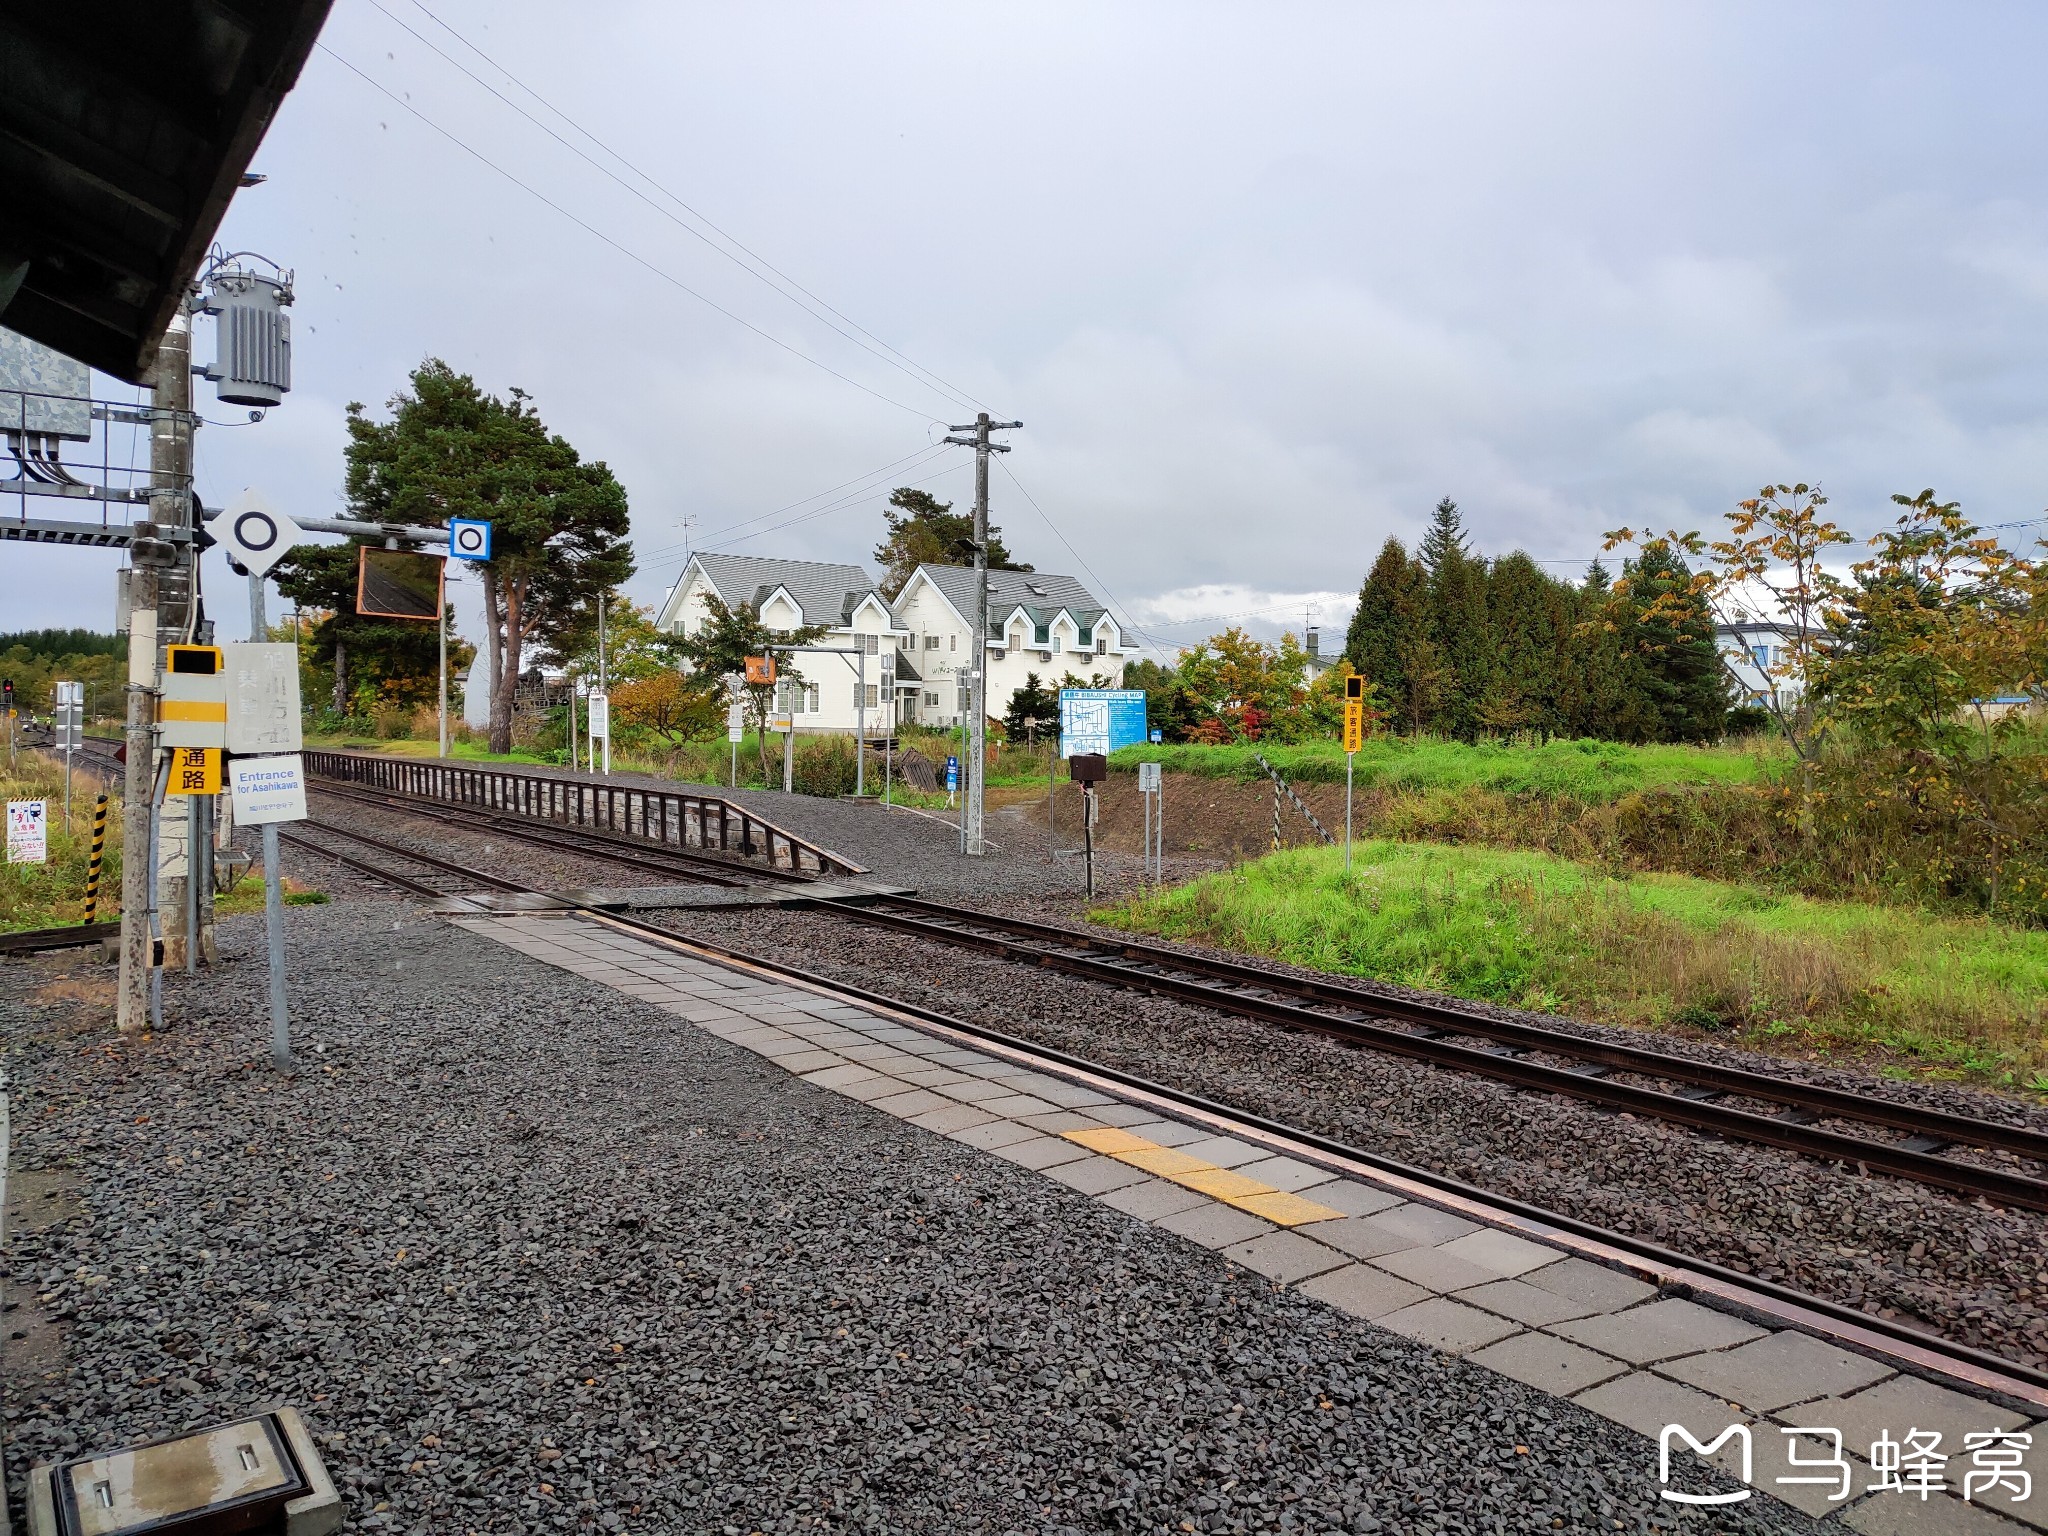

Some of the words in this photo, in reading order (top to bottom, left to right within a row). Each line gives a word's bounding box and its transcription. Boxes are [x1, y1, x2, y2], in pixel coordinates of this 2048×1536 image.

[182, 748, 205, 789] 通路
[239, 770, 294, 782] Entrance
[237, 784, 250, 794] for
[252, 781, 299, 793] Asahikawa
